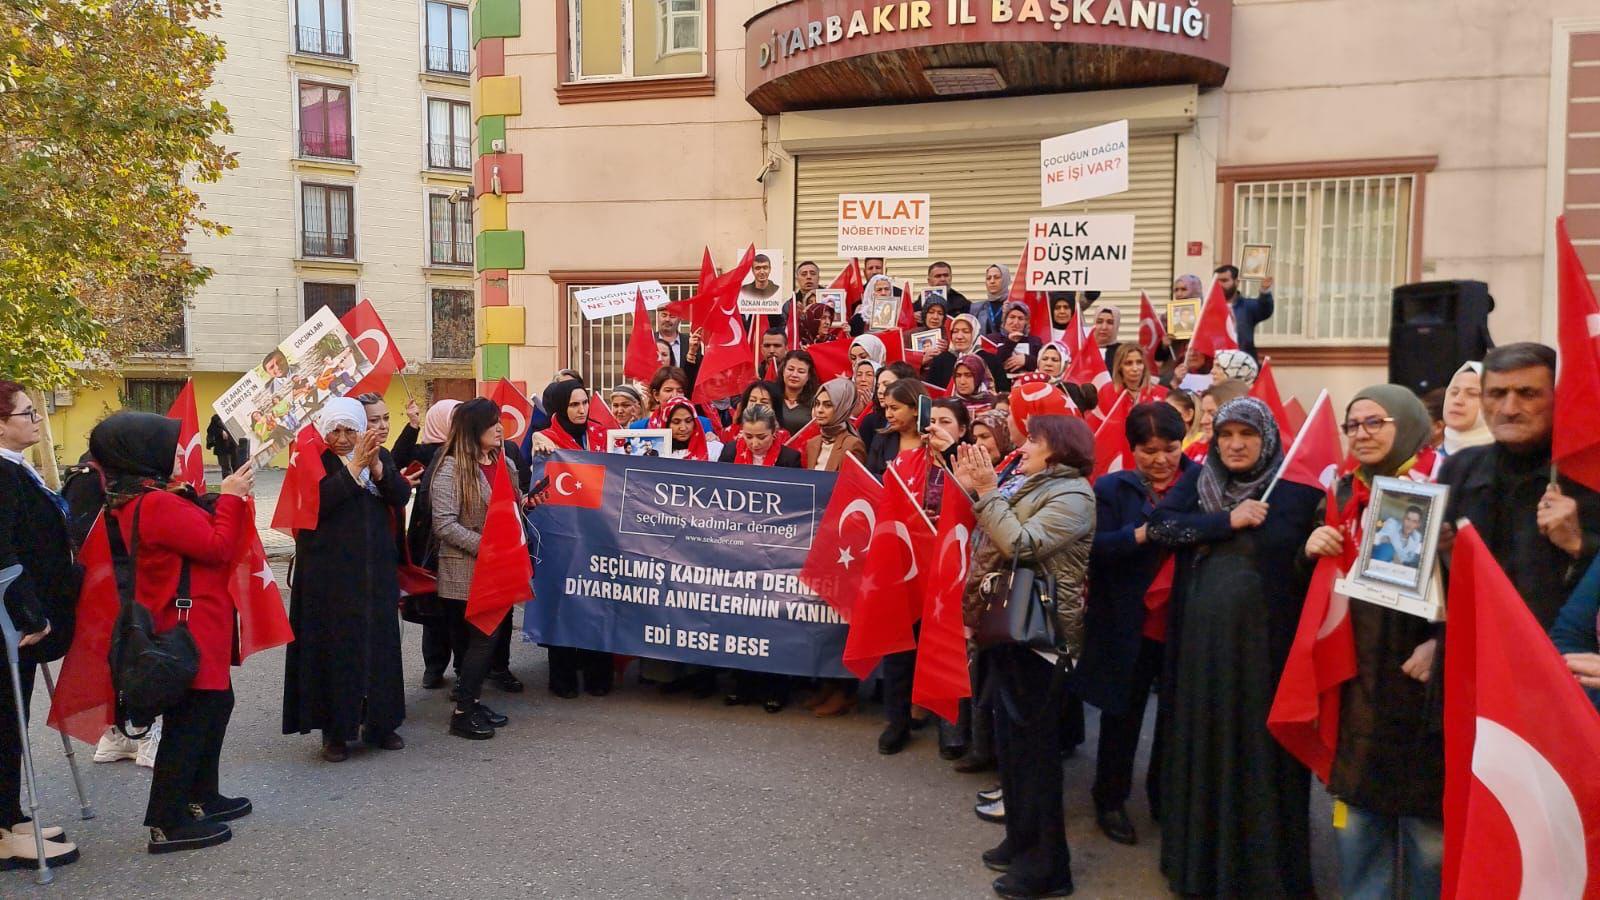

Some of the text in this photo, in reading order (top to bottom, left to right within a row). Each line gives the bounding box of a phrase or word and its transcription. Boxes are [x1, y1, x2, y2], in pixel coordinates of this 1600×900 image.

[759, 0, 933, 68] DİYARBAKIR
[991, 0, 1210, 40] BAŞKANLIĞI
[1043, 140, 1126, 169] ÇOCUĞUN DAĞDA
[1047, 157, 1122, 184] NE İŞİ VAR?
[842, 199, 926, 220] EVLAT
[842, 224, 925, 235] NÖBETİNDEYİZ
[1035, 221, 1089, 238] HALK
[841, 244, 925, 252] DİYARBAKIR ANNELERİ
[1033, 243, 1127, 265] DÜŞMANI
[1032, 267, 1089, 286] PARTİ
[627, 294, 662, 303] VR?
[294, 320, 324, 349] ÇOCUKLARI
[653, 482, 784, 516] SEKADER
[636, 512, 798, 539] seçilmiş kadınlar derneği
[685, 535, 745, 546] www.sekader.com
[589, 554, 666, 585] SEÇİLMİŞ
[670, 564, 757, 591] KADINLAR
[565, 574, 660, 606] DİYARBAKIR
[664, 590, 780, 618] ANNELERİNİN
[644, 624, 770, 657] EDİ BESE BESE
